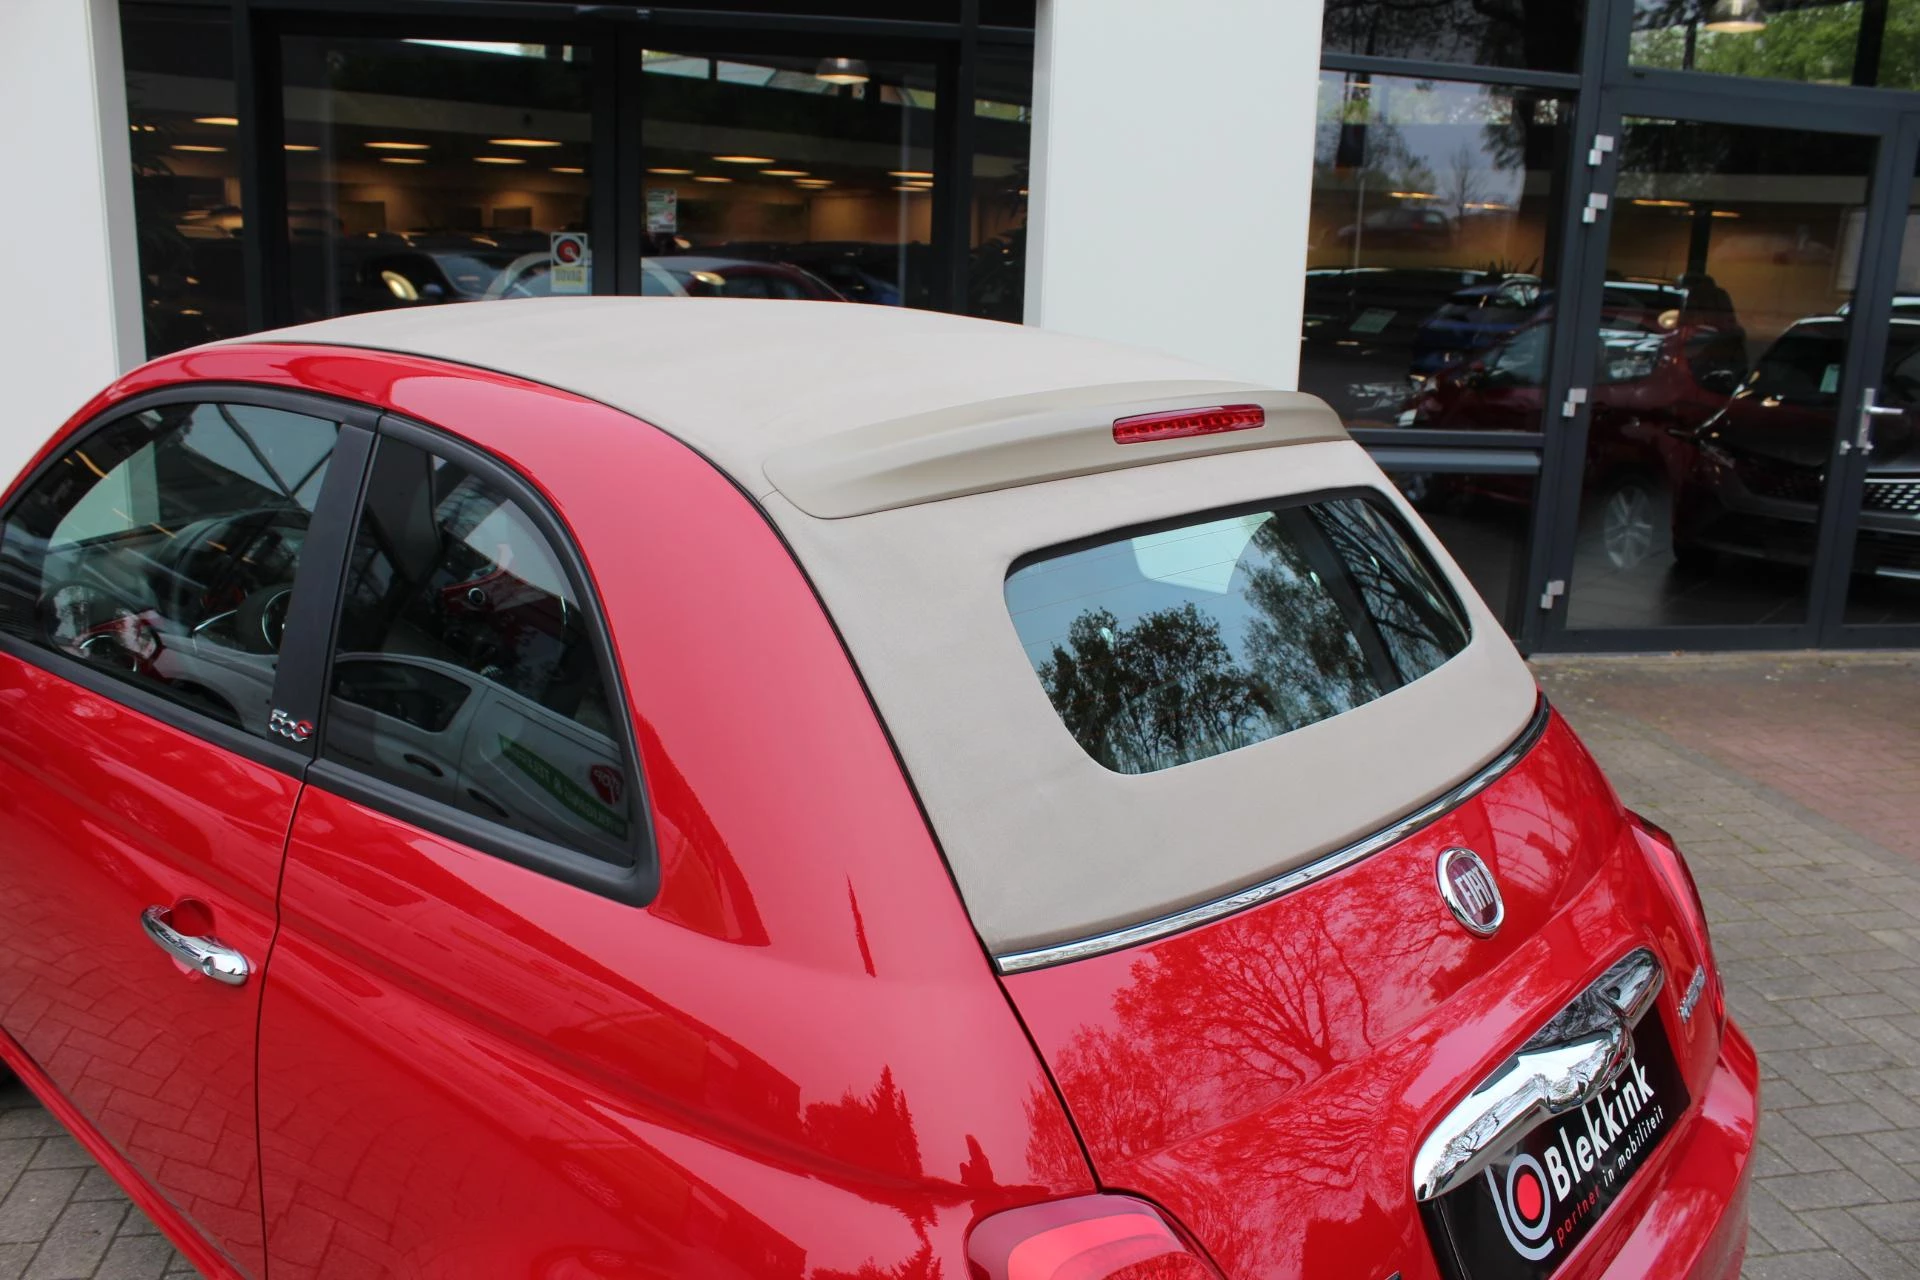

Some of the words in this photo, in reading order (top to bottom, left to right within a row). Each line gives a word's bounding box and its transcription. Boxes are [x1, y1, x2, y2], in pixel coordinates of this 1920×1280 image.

[1454, 866, 1494, 915] FIAT
[1543, 1057, 1655, 1203] Blekkink
[1556, 1185, 1600, 1247] partner
[1602, 1170, 1614, 1187] in
[1617, 1104, 1665, 1170] mobiliteit
